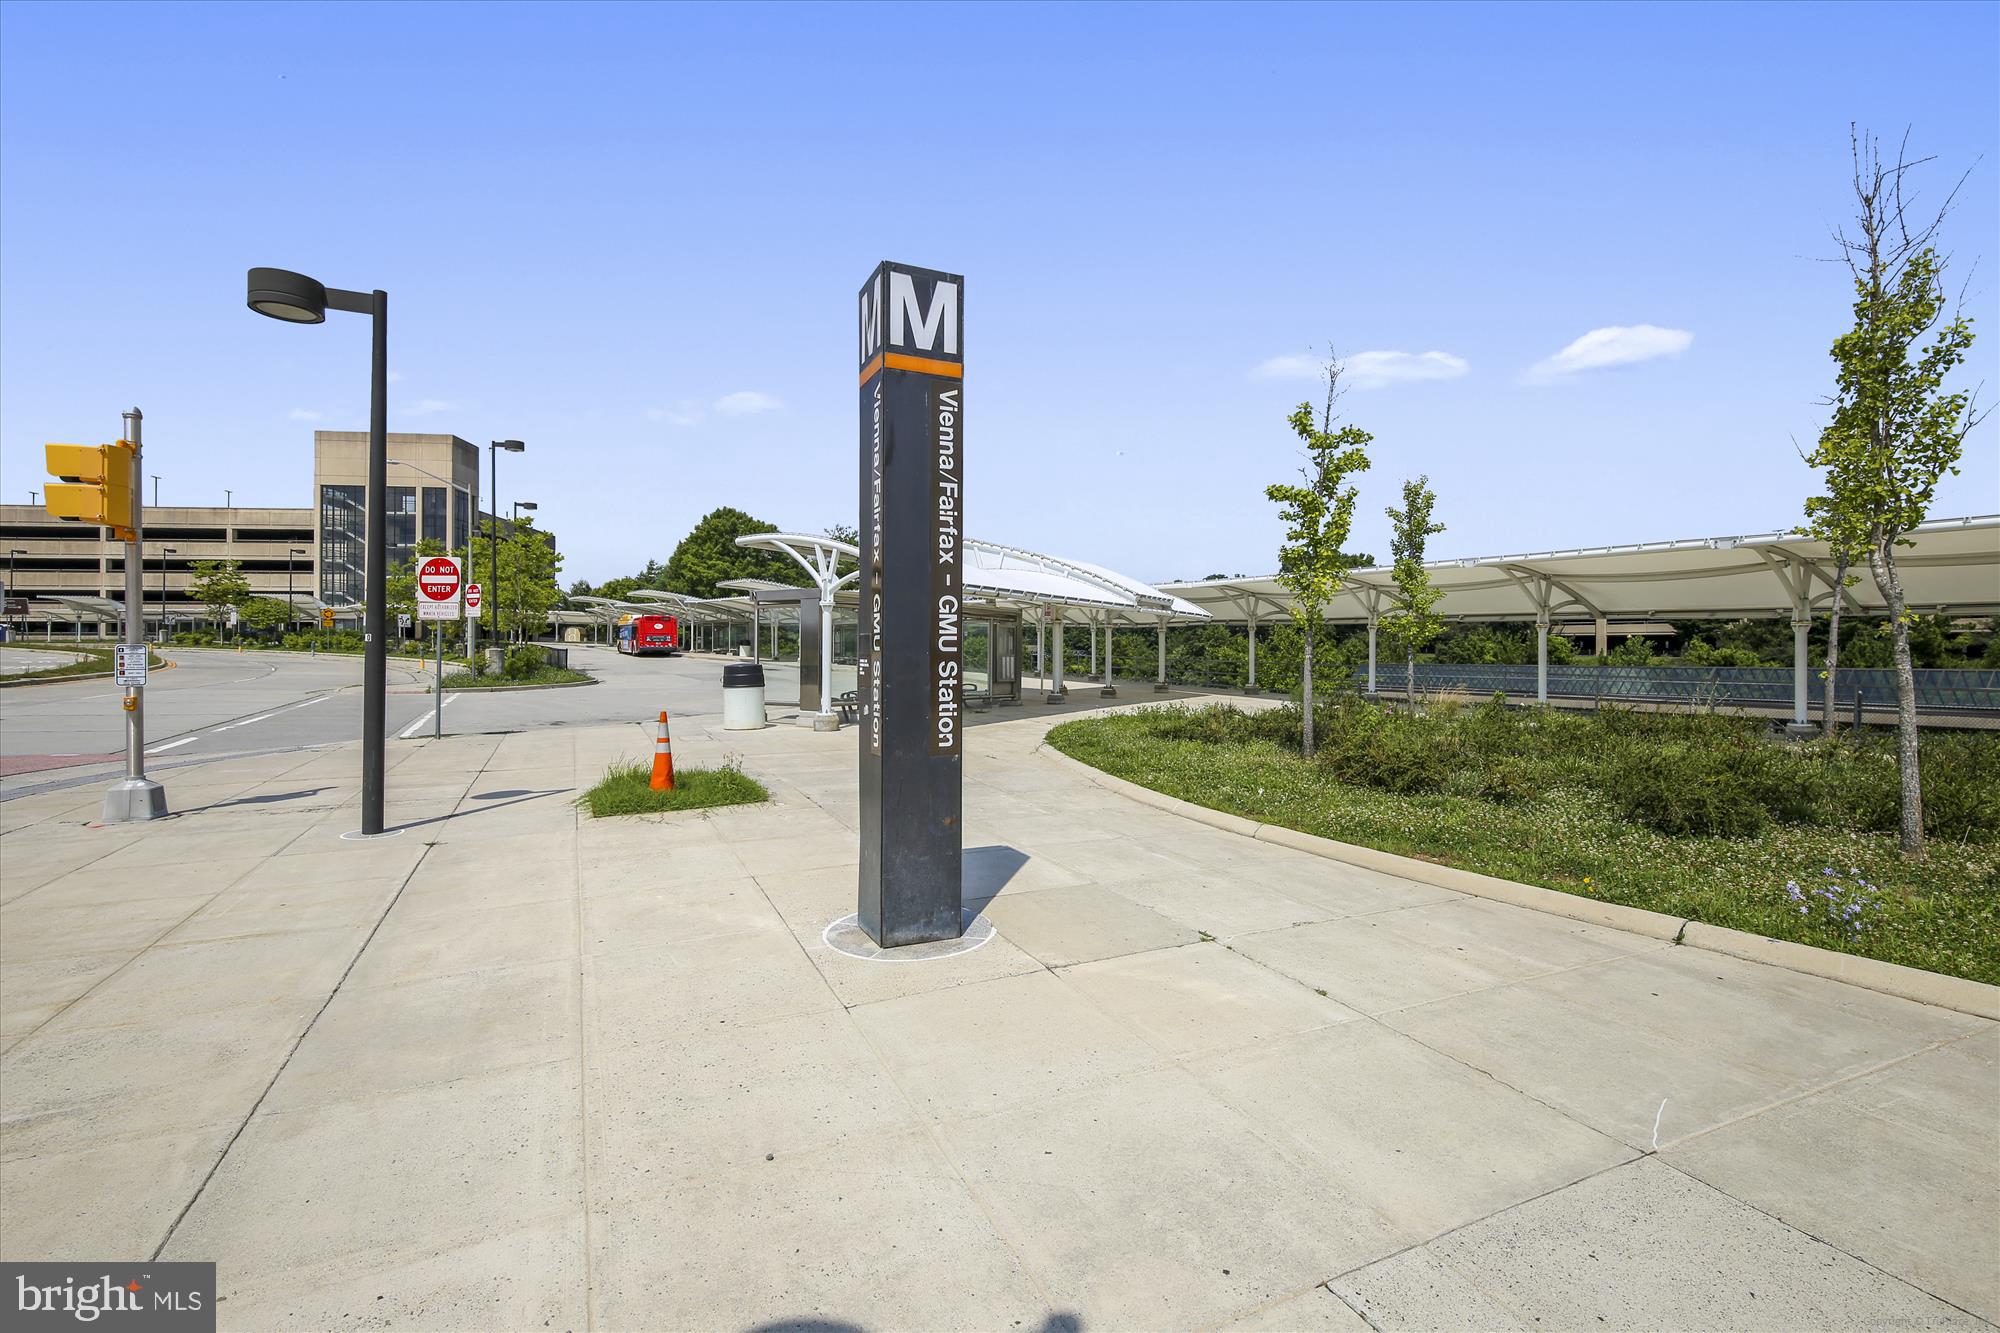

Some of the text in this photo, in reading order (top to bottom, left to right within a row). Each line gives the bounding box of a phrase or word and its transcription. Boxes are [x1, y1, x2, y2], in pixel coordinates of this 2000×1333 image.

[861, 273, 882, 365] M
[889, 271, 958, 355] M
[873, 381, 881, 563] Vienna/Fairfax
[939, 389, 959, 565] Vienna/Fairfax
[427, 585, 451, 593] ENTER
[873, 593, 881, 651] GMU
[938, 595, 959, 652] GMU
[873, 660, 881, 748] Station
[938, 660, 958, 748] Station
